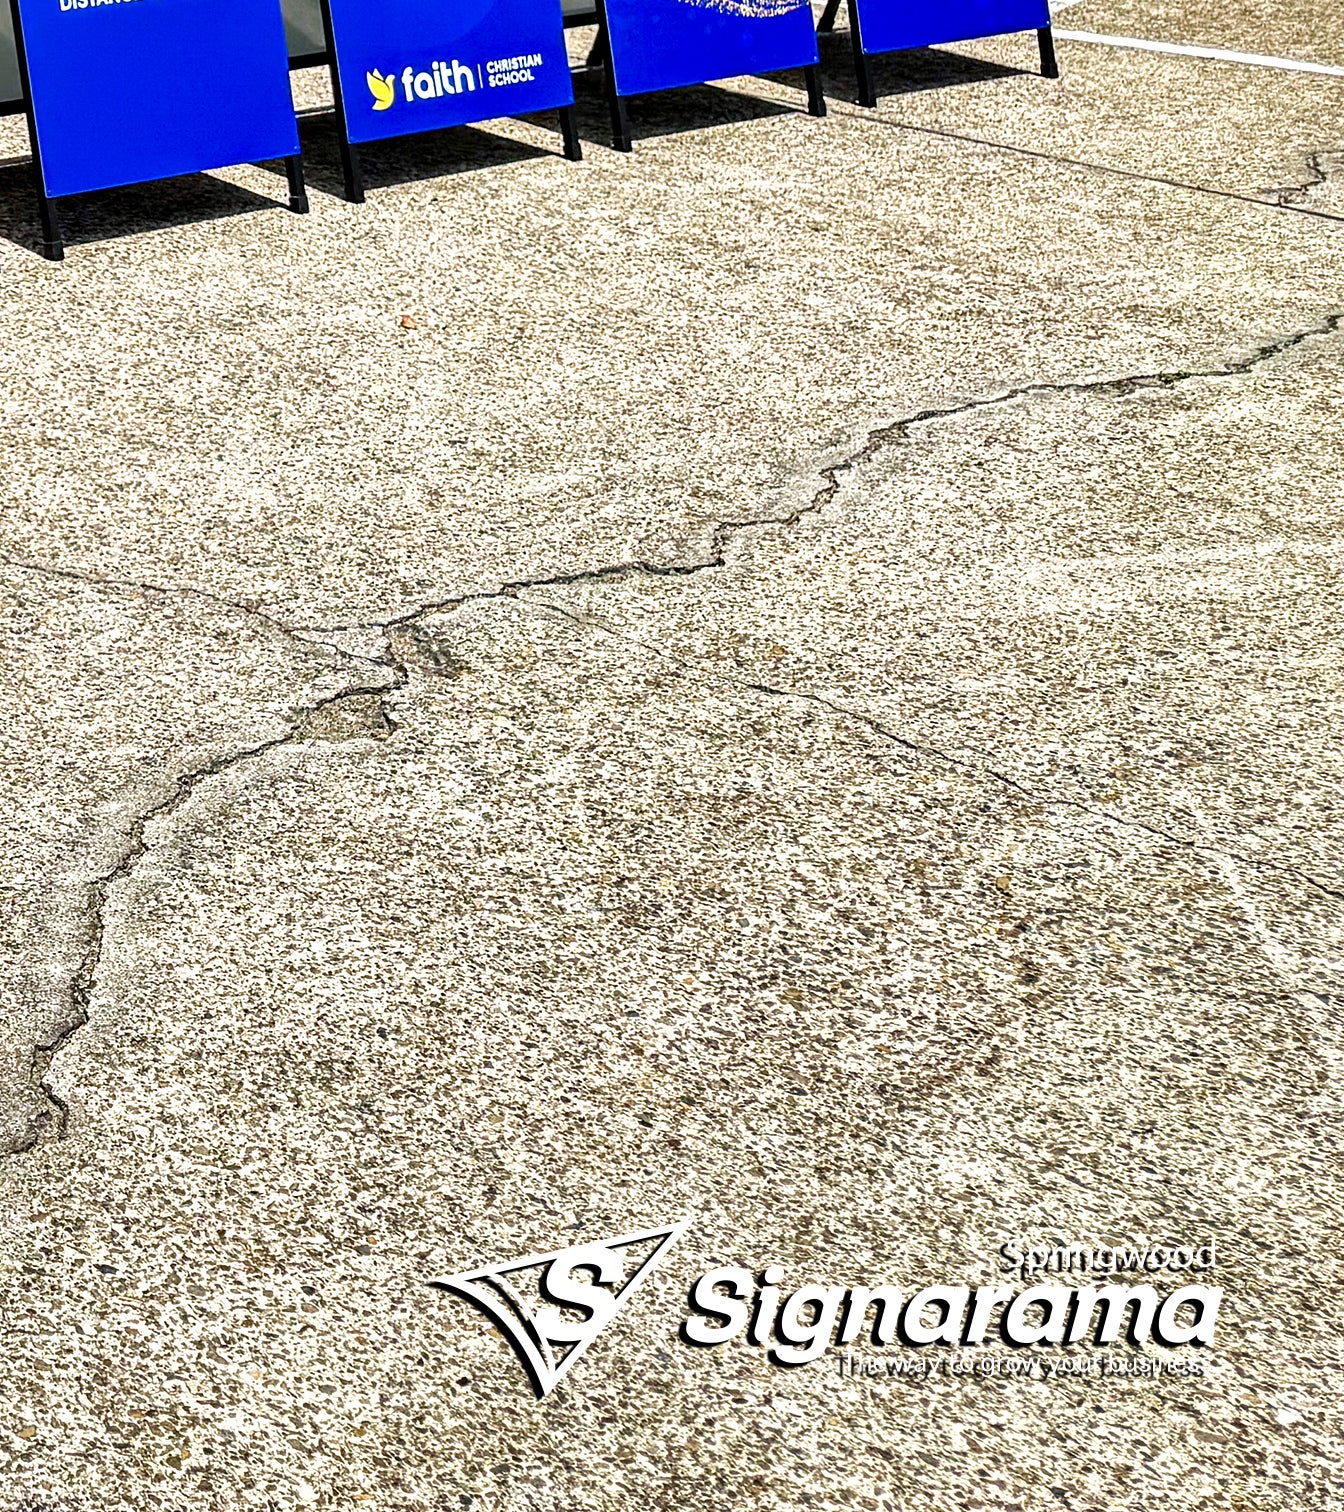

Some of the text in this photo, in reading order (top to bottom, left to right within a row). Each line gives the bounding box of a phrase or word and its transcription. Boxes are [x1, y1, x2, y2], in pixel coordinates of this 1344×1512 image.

[401, 53, 543, 103] faith CHRISTIAN
[488, 69, 535, 89] SCHOOL
